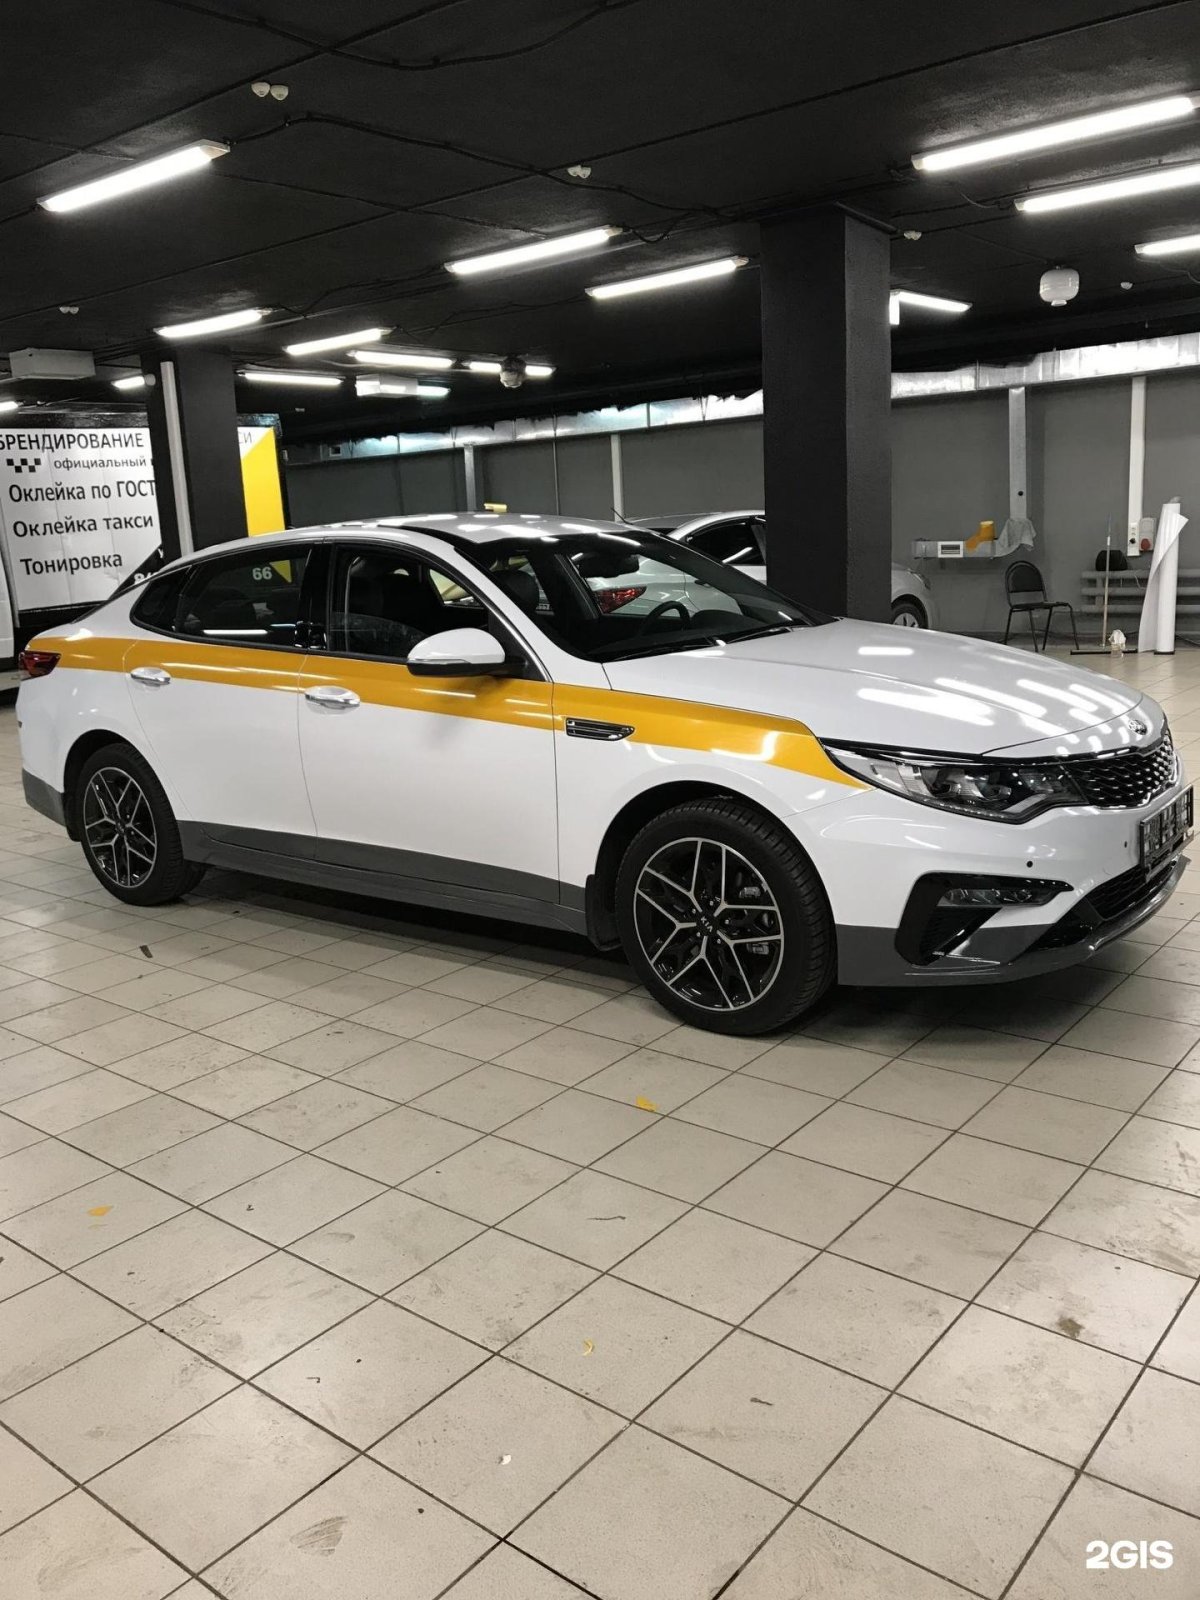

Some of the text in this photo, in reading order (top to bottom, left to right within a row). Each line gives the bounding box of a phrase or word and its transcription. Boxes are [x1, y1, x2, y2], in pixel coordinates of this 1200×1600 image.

[54, 456, 146, 471] официальный
[9, 482, 85, 502] Оклейка
[91, 485, 111, 499] по
[13, 515, 153, 537] Оклейка такси
[20, 554, 122, 575] Тонировка
[252, 566, 273, 580] 66
